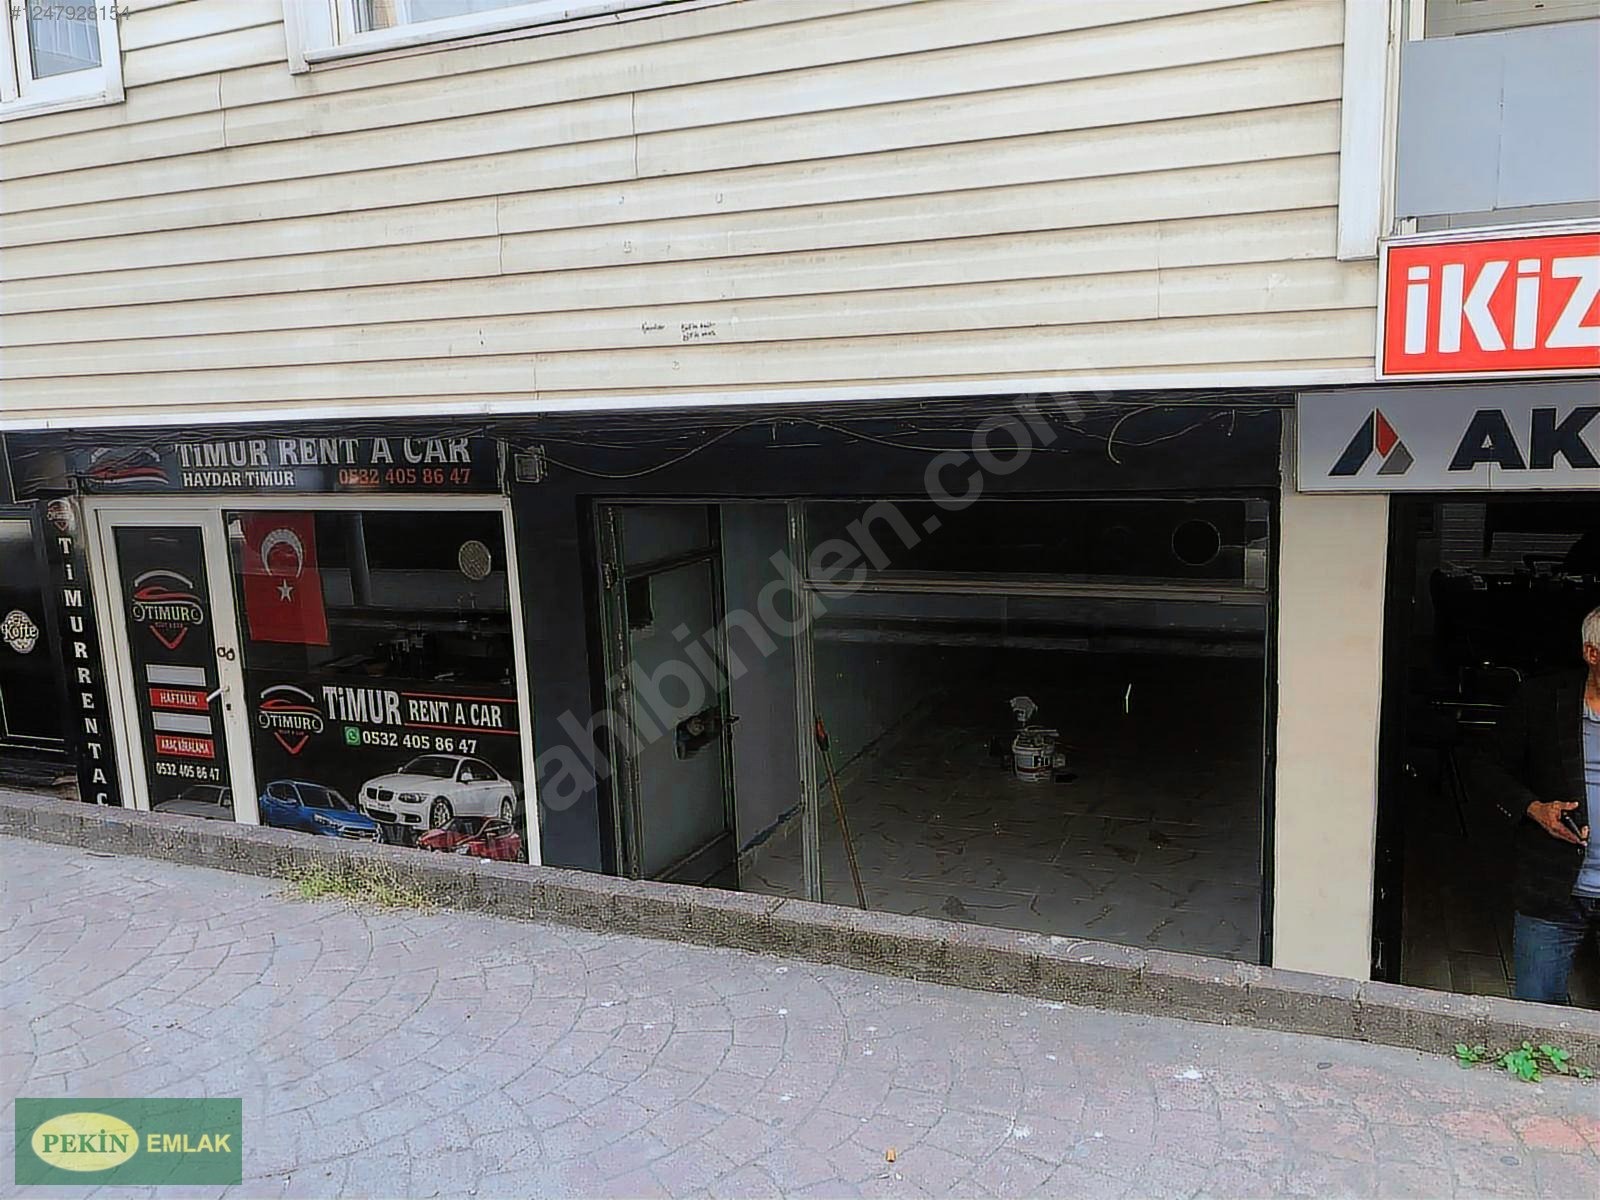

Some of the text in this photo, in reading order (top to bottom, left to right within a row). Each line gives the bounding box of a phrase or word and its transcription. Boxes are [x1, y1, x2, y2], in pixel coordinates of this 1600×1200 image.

[278, 437, 359, 466] RENT
[371, 437, 394, 464] A
[403, 437, 472, 464] CAR
[183, 471, 241, 487] HAYDAR
[385, 467, 416, 485] 405
[423, 467, 444, 485] 86
[450, 467, 472, 484] 47
[408, 699, 450, 724] RENT
[455, 702, 467, 725] A
[470, 703, 502, 727] CAR
[362, 730, 477, 754] 0532 405 86 47
[156, 762, 220, 781] 0532 405 86 47
